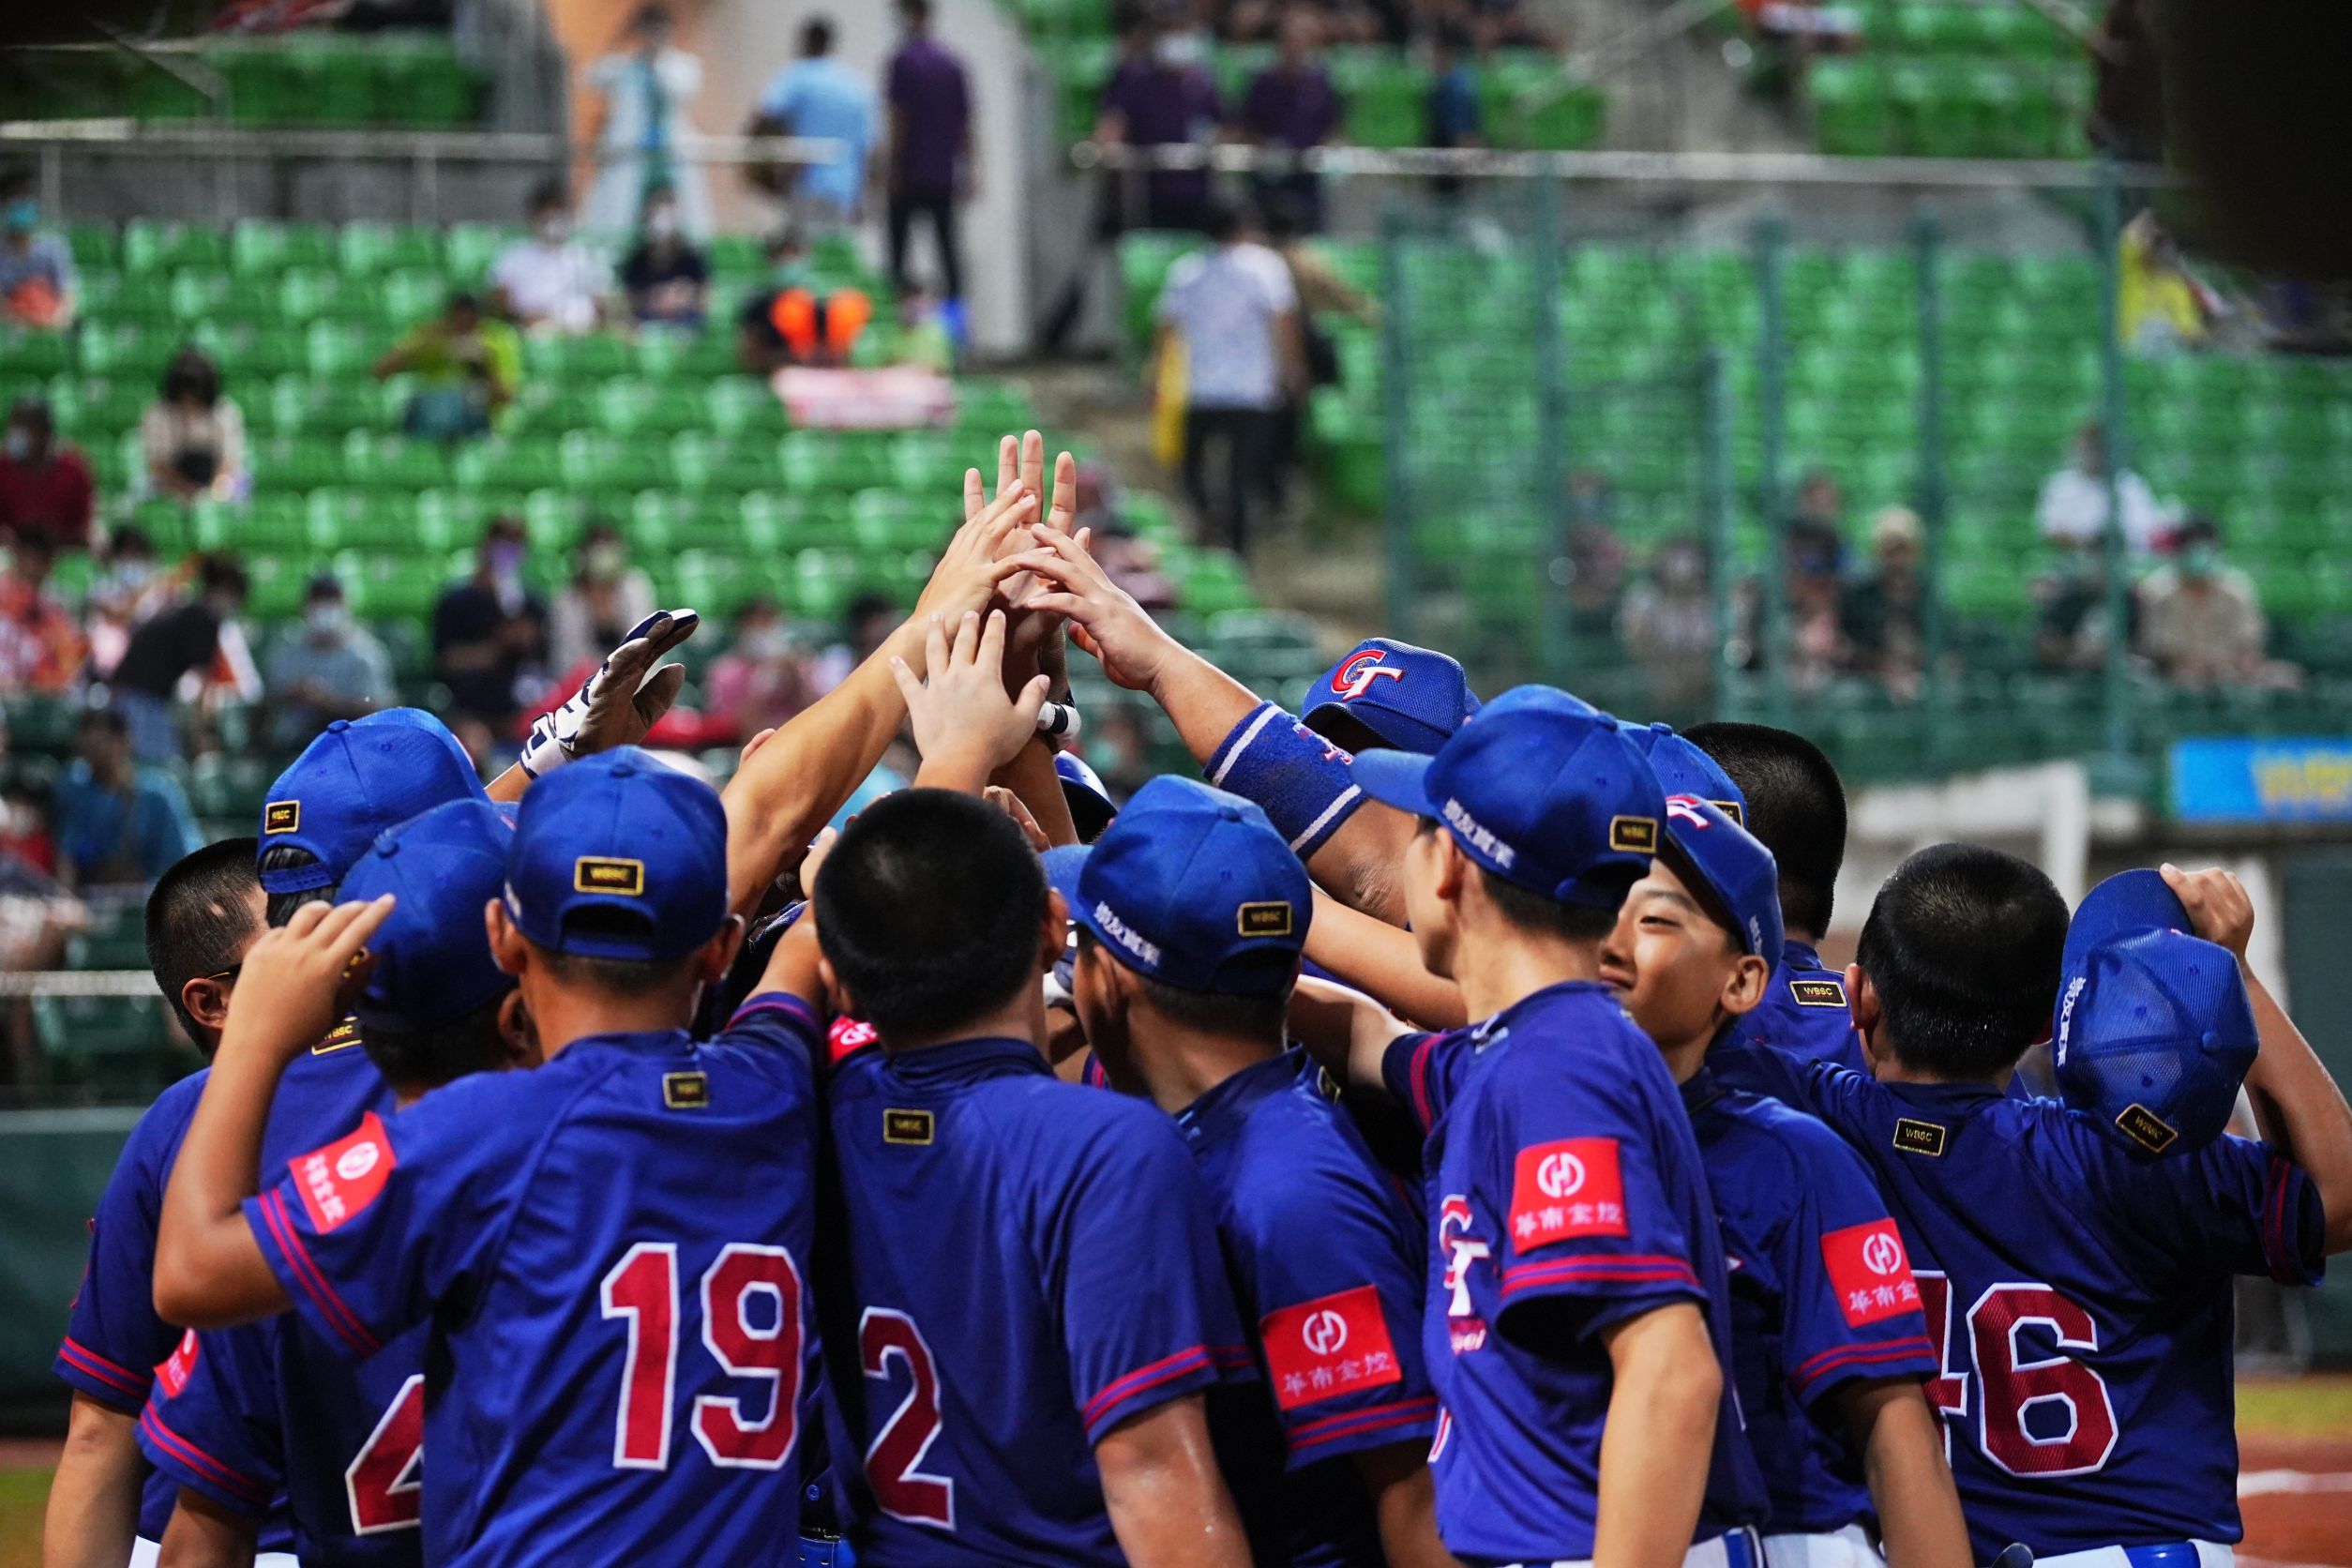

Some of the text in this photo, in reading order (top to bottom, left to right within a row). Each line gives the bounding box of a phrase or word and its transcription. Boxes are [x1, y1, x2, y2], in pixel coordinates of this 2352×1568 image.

[1802, 987, 1832, 997] WBSC
[1905, 1127, 1933, 1141] WBSC
[2133, 1115, 2163, 1139] WBSC
[600, 1242, 805, 1470] 19
[1284, 1351, 1392, 1397] 華南金控
[858, 1305, 957, 1530] 2
